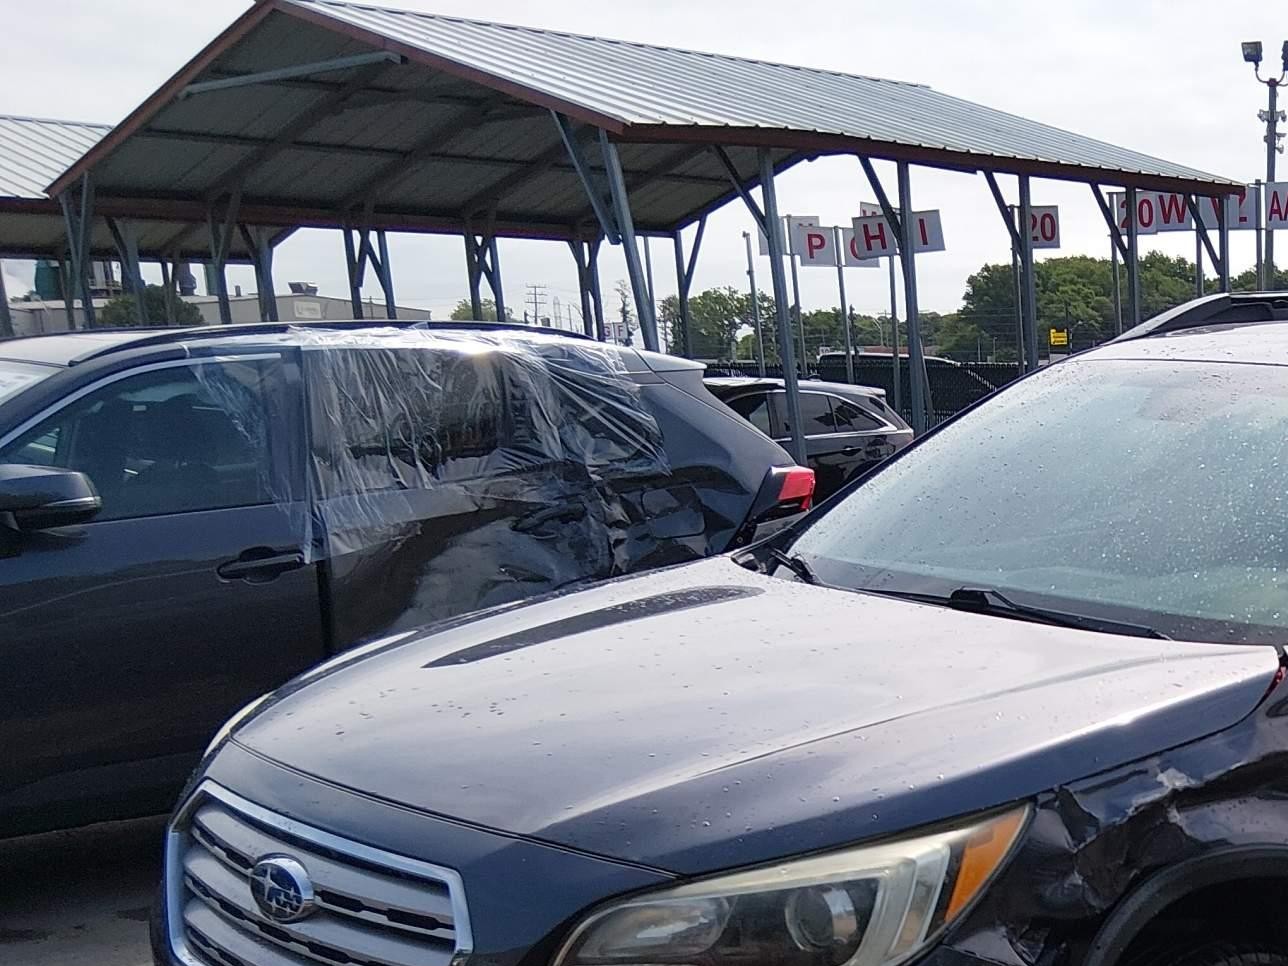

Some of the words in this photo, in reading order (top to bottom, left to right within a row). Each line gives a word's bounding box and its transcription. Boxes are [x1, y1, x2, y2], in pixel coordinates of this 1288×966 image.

[1159, 194, 1187, 224] W
[807, 233, 825, 259] P
[862, 222, 887, 251] H
[918, 218, 928, 246] I
